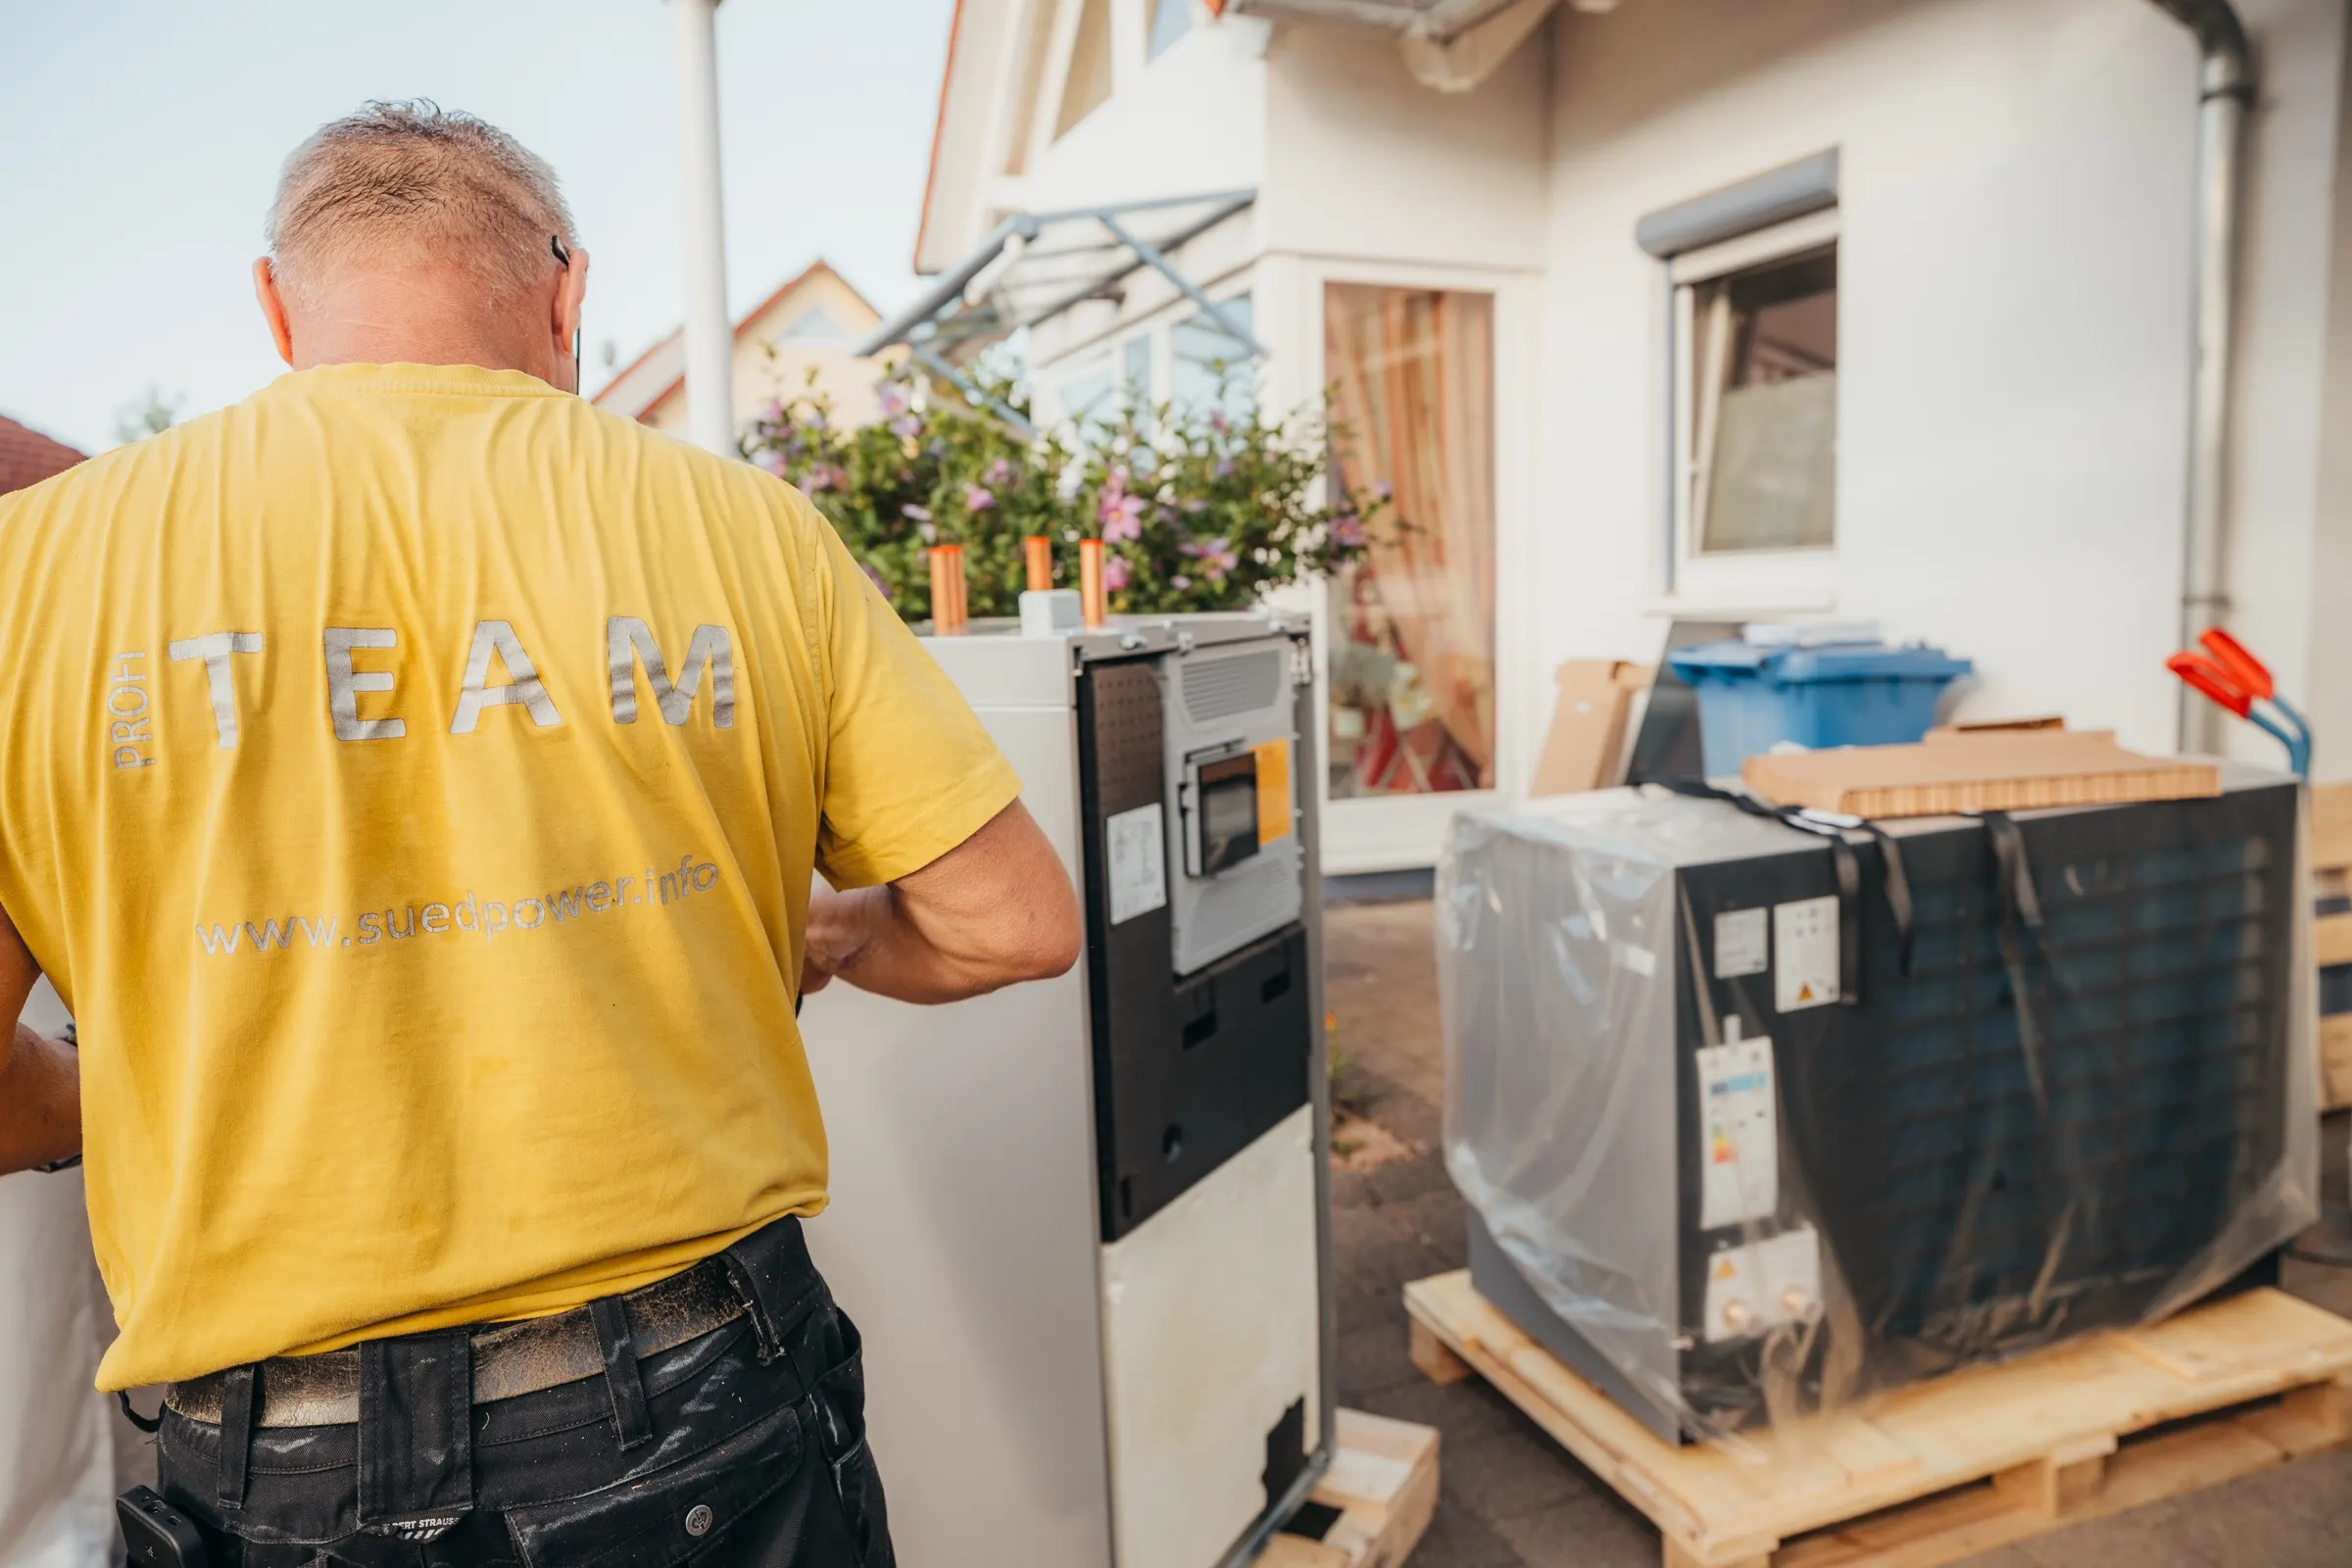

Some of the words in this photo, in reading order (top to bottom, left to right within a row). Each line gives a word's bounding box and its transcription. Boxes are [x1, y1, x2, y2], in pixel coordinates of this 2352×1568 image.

[107, 651, 157, 770] PROFI
[168, 615, 735, 750] TEAM
[196, 855, 719, 955] www.suedpower.info
